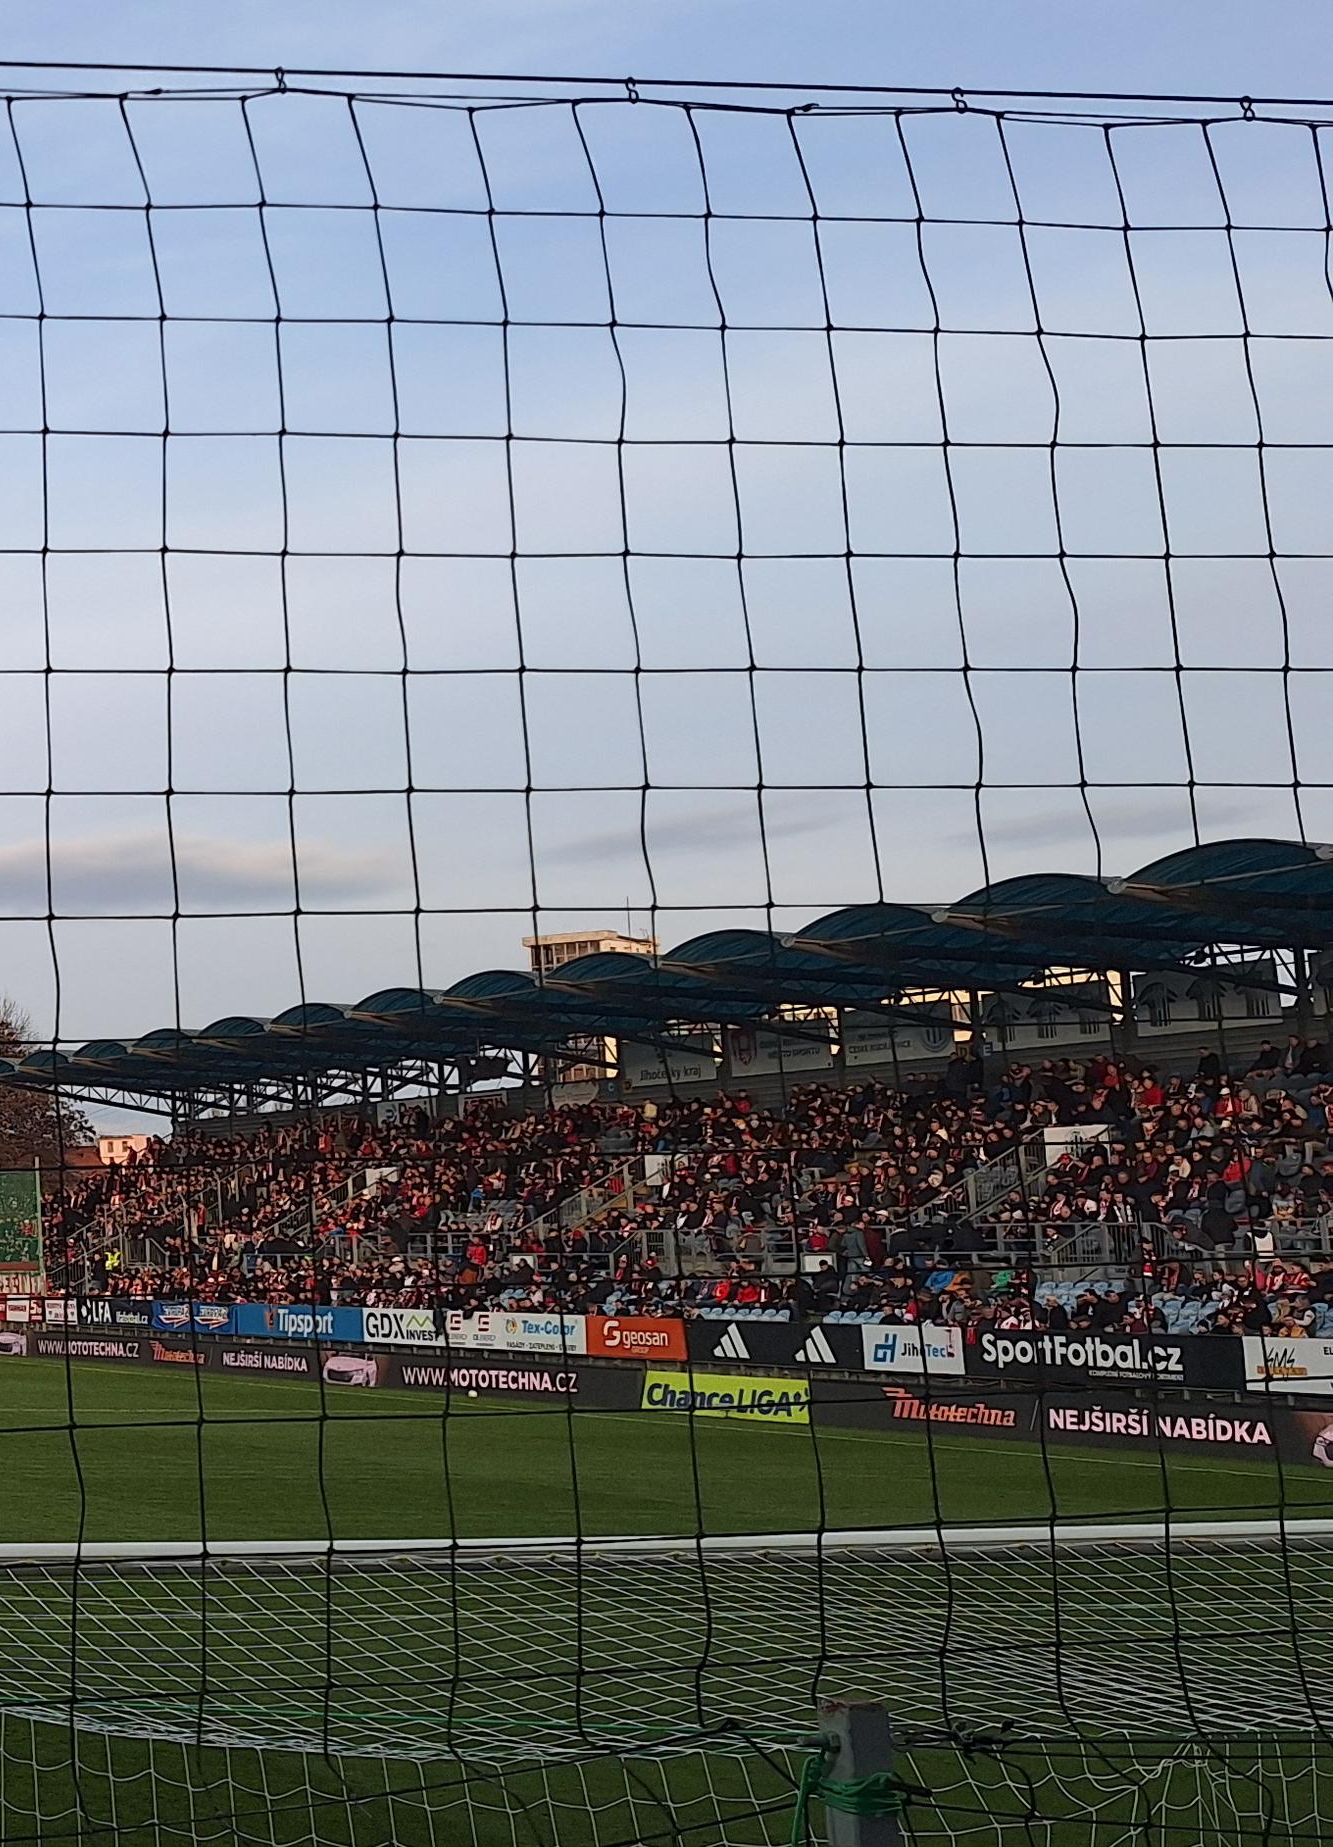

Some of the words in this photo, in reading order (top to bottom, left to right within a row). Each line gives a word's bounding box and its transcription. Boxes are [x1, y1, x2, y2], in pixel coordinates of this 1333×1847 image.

[640, 1067, 681, 1081] Jihočeký
[684, 1066, 702, 1079] kraj
[92, 1300, 112, 1323] LFA
[365, 1311, 404, 1340] GDX
[622, 1331, 669, 1348] geosan
[222, 1350, 263, 1369] NEJŠIRŠÍ
[264, 1351, 308, 1373] NABÍDKA
[401, 1365, 578, 1393] WWW.MOTOTECHNA.CZ
[647, 1382, 735, 1409] Chance
[737, 1386, 794, 1417] LIGA
[1048, 1404, 1150, 1437] NEJŠIRŠÍ
[1154, 1412, 1273, 1445] NABÍDKA
